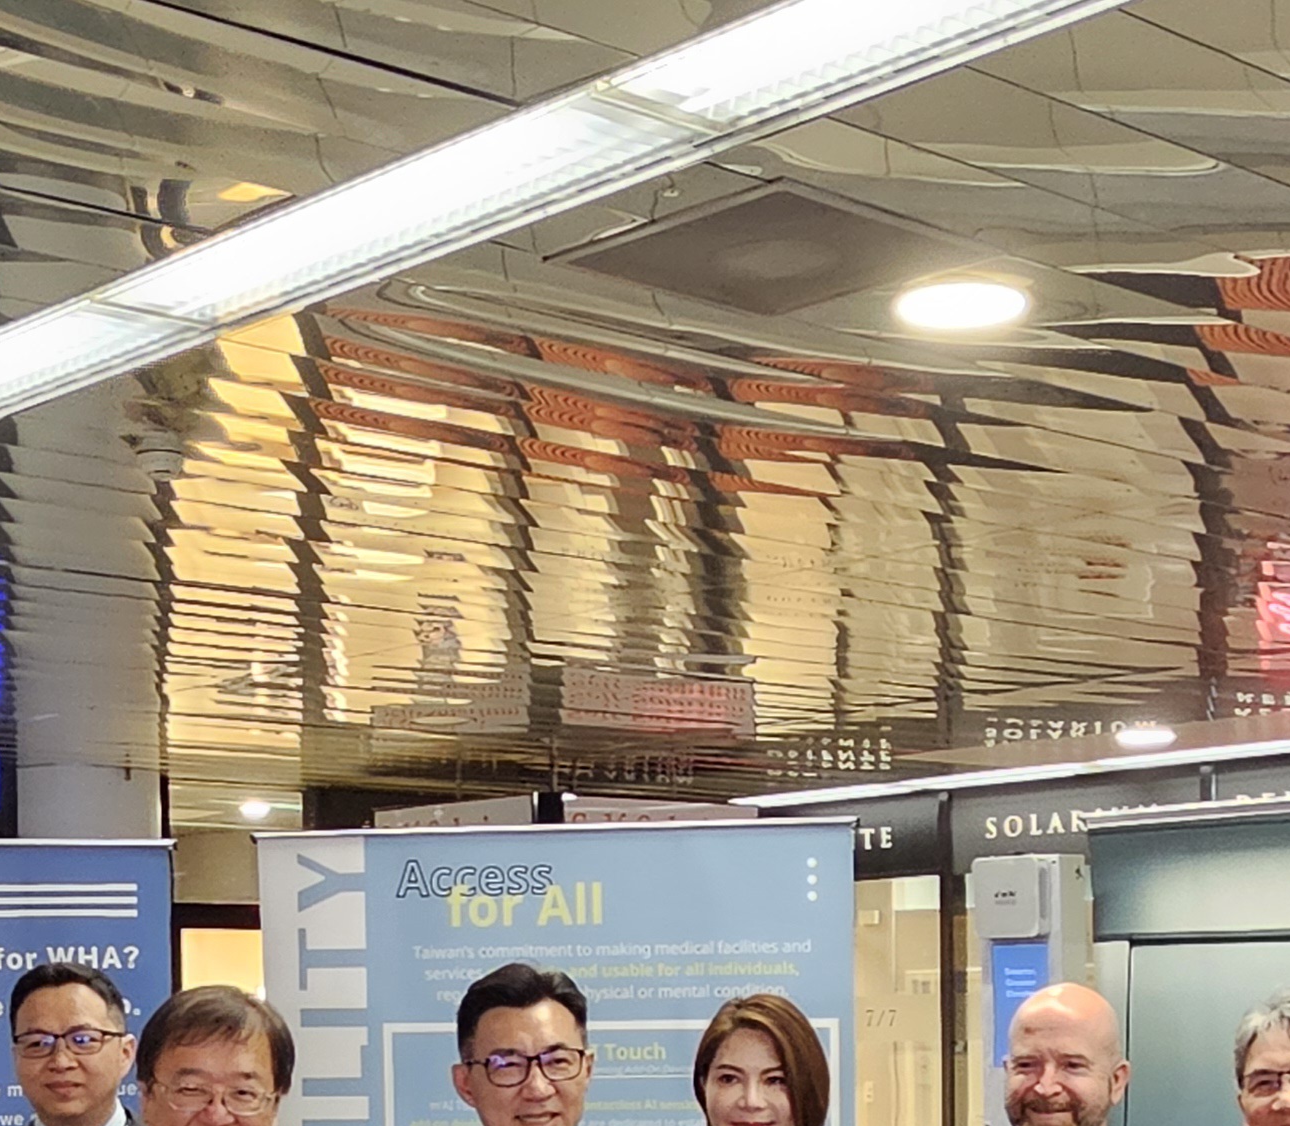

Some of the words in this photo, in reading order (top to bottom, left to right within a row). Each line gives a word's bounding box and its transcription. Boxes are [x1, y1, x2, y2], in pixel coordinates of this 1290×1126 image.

[396, 859, 553, 898] Access
[446, 883, 525, 927] for
[537, 881, 603, 926] All
[46, 946, 139, 969] WHA?
[478, 944, 571, 958] commitment
[576, 944, 592, 956] to
[596, 942, 651, 959] making
[655, 940, 713, 956] medical
[718, 939, 778, 954] facilities
[782, 939, 811, 953] and
[425, 966, 483, 981] services
[602, 963, 654, 977] usable
[659, 962, 679, 977] for
[685, 962, 704, 976] all
[711, 961, 799, 977] individuals,
[638, 987, 653, 999] or
[658, 984, 709, 998] mental
[604, 1043, 666, 1060] Touch
[0, 1114, 24, 1126] we
